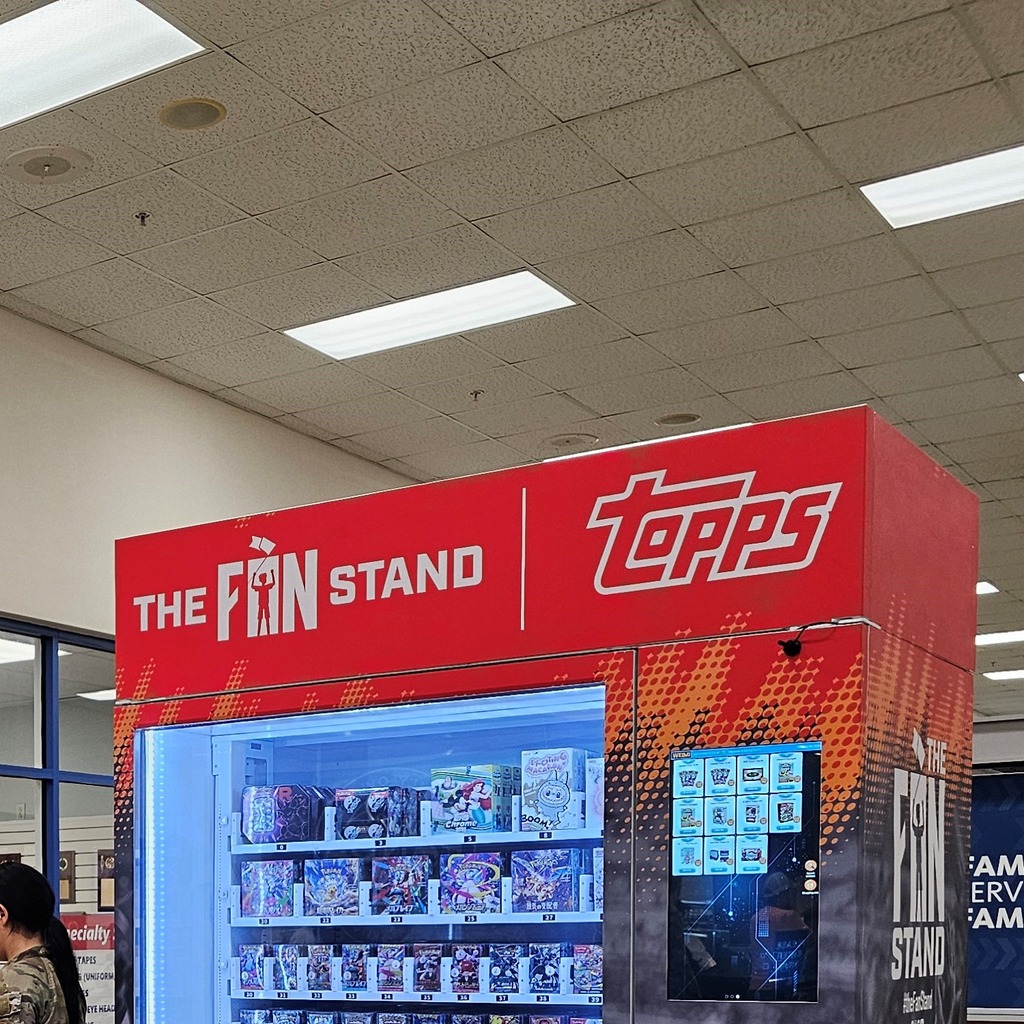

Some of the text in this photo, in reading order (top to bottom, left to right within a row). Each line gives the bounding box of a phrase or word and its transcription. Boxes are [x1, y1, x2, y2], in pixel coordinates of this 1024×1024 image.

[133, 585, 207, 633] THE
[329, 545, 483, 606] STAND
[927, 737, 947, 775] THE
[67, 924, 111, 945] ecialty
[78, 956, 97, 965] TAPES
[891, 926, 944, 980] STAND
[83, 972, 114, 982] (UNIFORM
[87, 1004, 115, 1014] EYE HEAD
[902, 989, 933, 1014] #theFanStand
